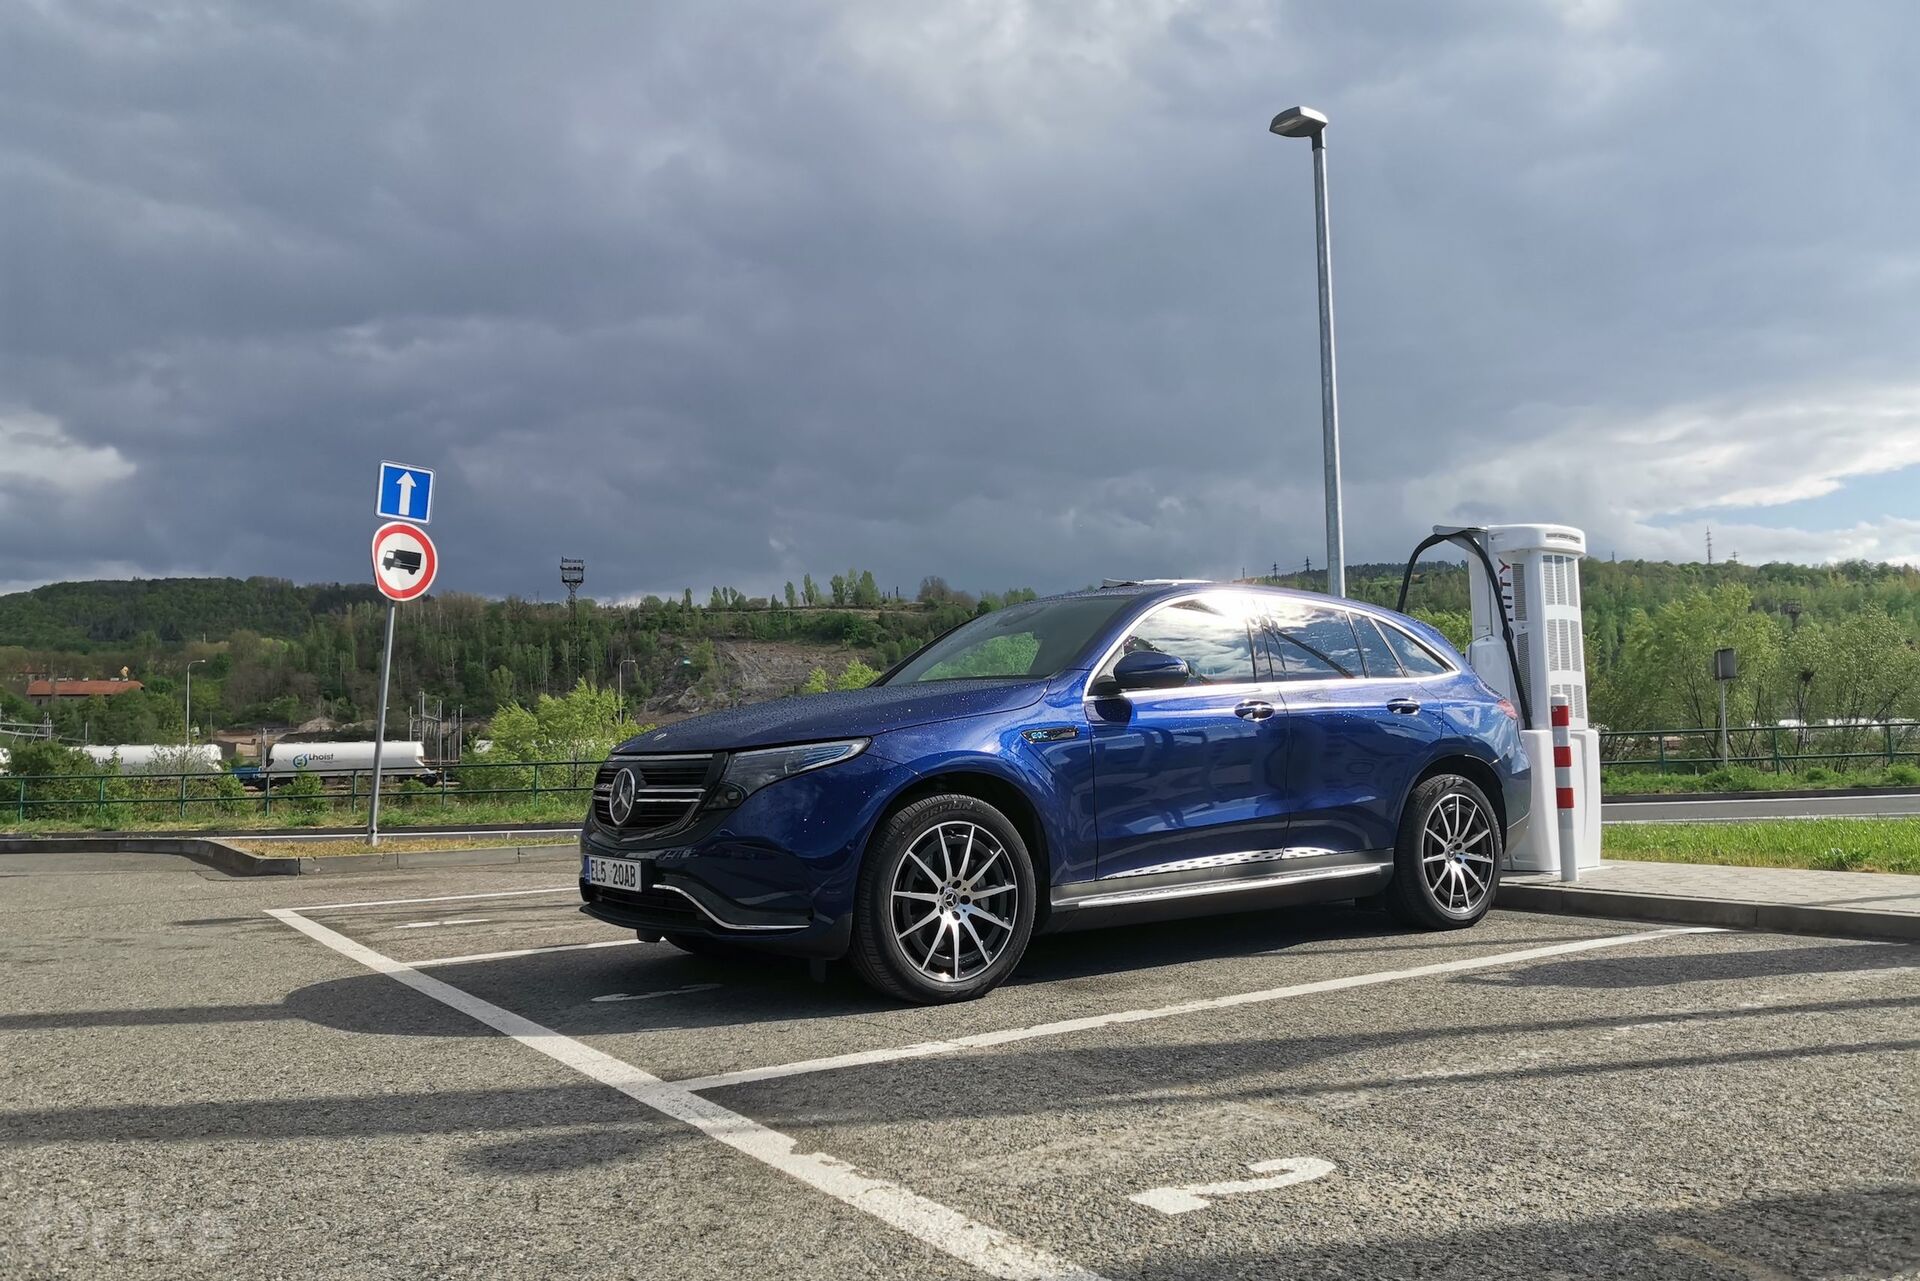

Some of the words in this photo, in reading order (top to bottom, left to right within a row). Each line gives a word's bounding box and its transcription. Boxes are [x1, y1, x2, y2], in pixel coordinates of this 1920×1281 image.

[308, 753, 334, 761] Lhoist
[591, 859, 606, 882] EL5
[612, 862, 636, 888] 20AB
[1129, 1156, 1337, 1215] 2
